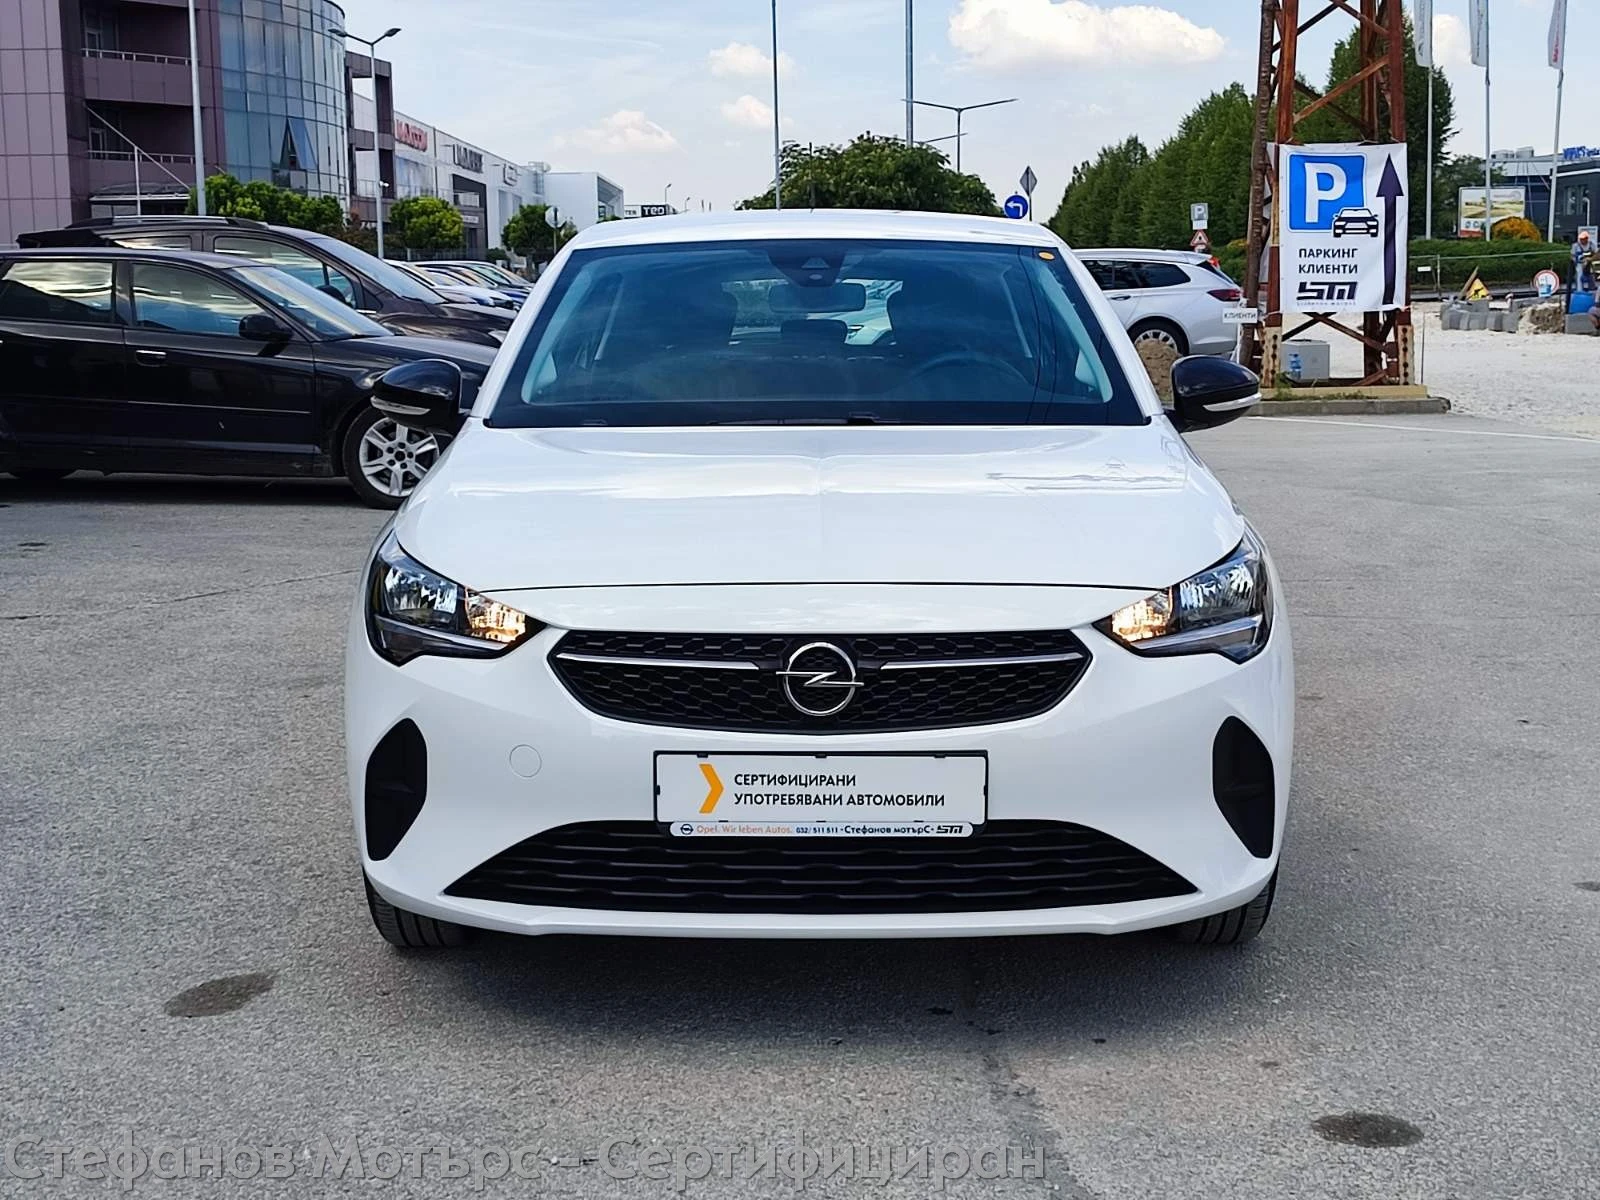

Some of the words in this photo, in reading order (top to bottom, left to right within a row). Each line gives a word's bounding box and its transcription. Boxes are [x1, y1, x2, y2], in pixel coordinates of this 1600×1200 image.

[1304, 162, 1346, 223] P
[1298, 248, 1358, 258] ПАРКИНГ
[1298, 264, 1358, 274] КЛИЕНТИ
[734, 773, 856, 787] СЕРТИФИЦИРАНИ
[734, 793, 843, 806] УПОТРЕБЯВАНИ
[846, 794, 945, 807] АВТОМОБИЛИ
